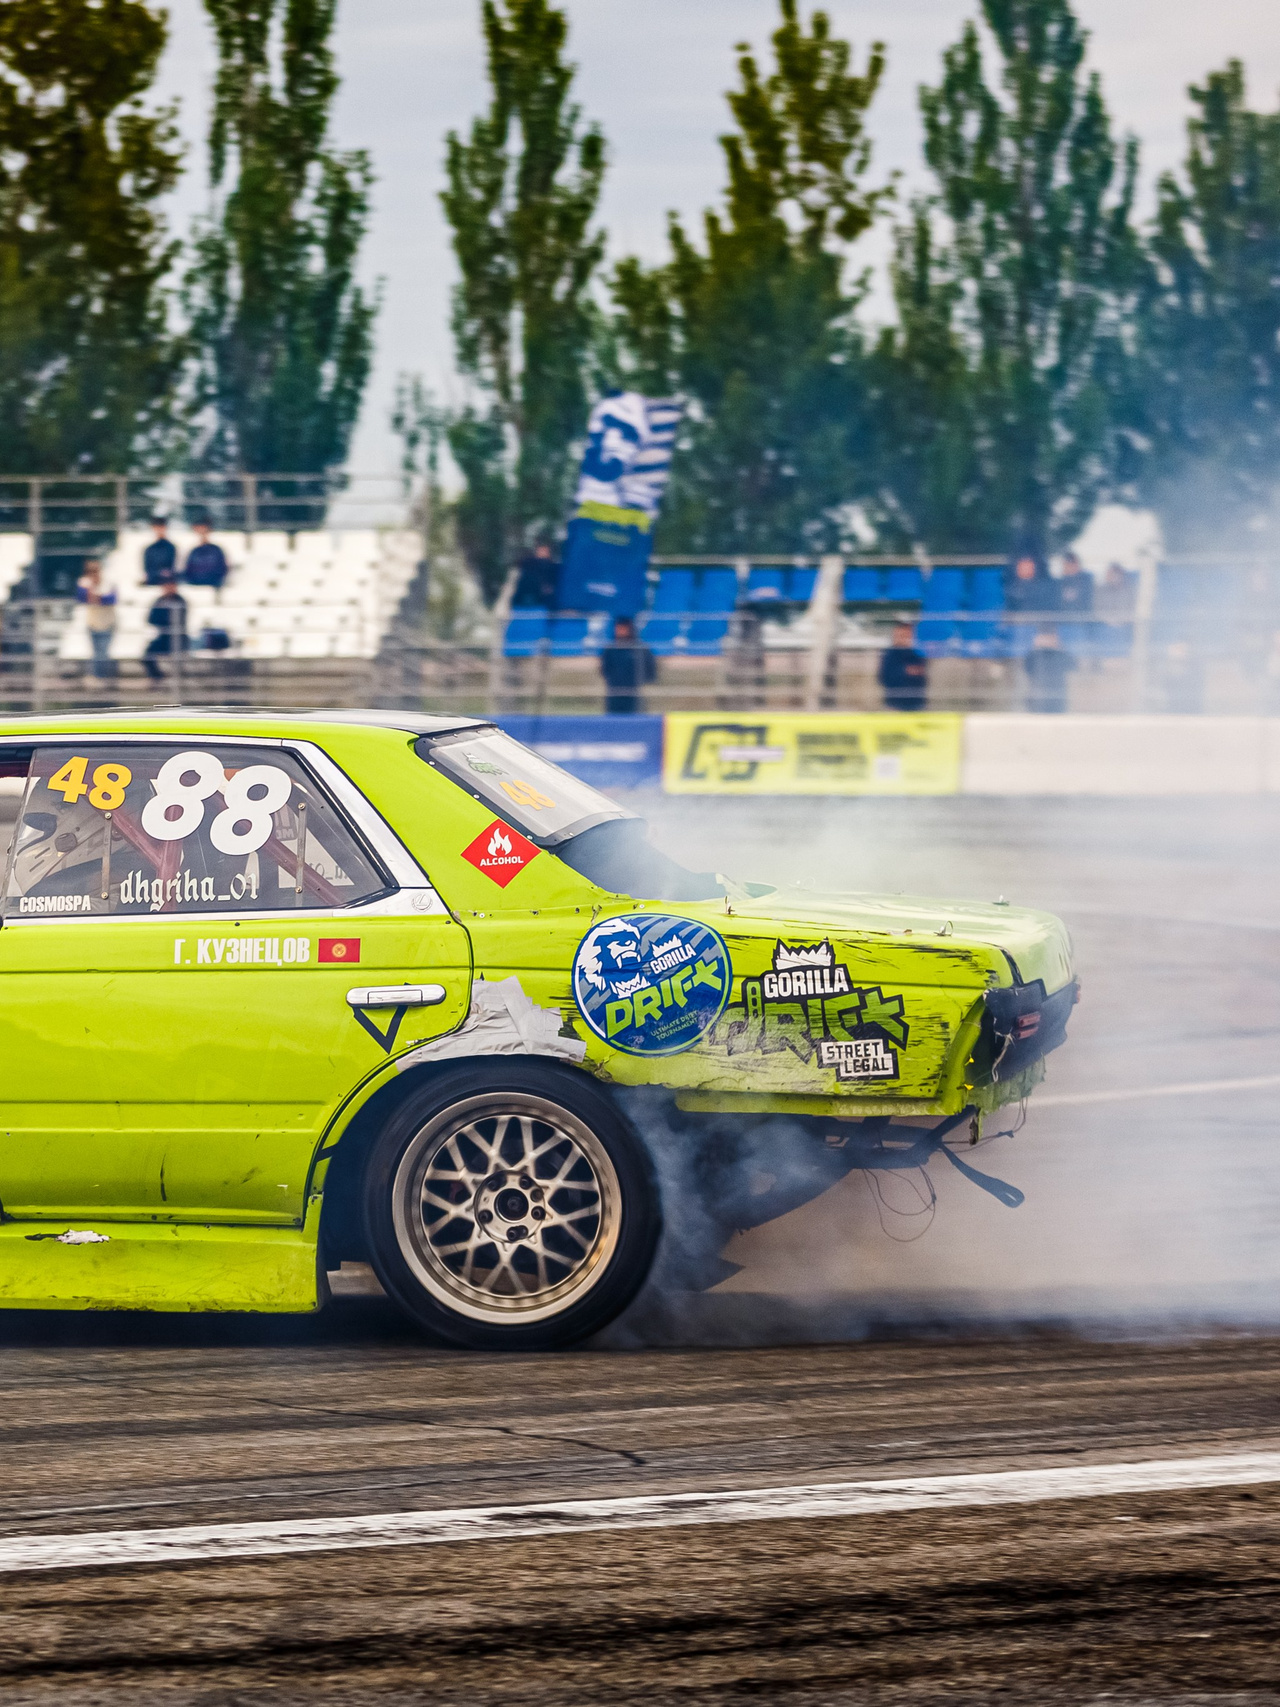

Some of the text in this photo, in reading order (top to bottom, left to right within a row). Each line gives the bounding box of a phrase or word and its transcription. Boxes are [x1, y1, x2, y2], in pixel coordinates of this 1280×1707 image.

[47, 756, 132, 810] 48
[499, 779, 556, 811] 48
[141, 751, 292, 855] 88
[480, 856, 524, 866] ALCOHOL
[20, 895, 91, 912] COSMOSPA
[174, 937, 310, 967] Г. КУЗНЕЦОВ
[650, 943, 696, 975] GORILLA
[764, 967, 849, 999] GORILLA
[605, 960, 722, 1039] DRIFT
[650, 1019, 680, 1037] ULTIMATE
[656, 1017, 698, 1041] TOURNAMENT
[826, 1042, 881, 1060] STREET
[844, 1057, 890, 1074] LEGAL
